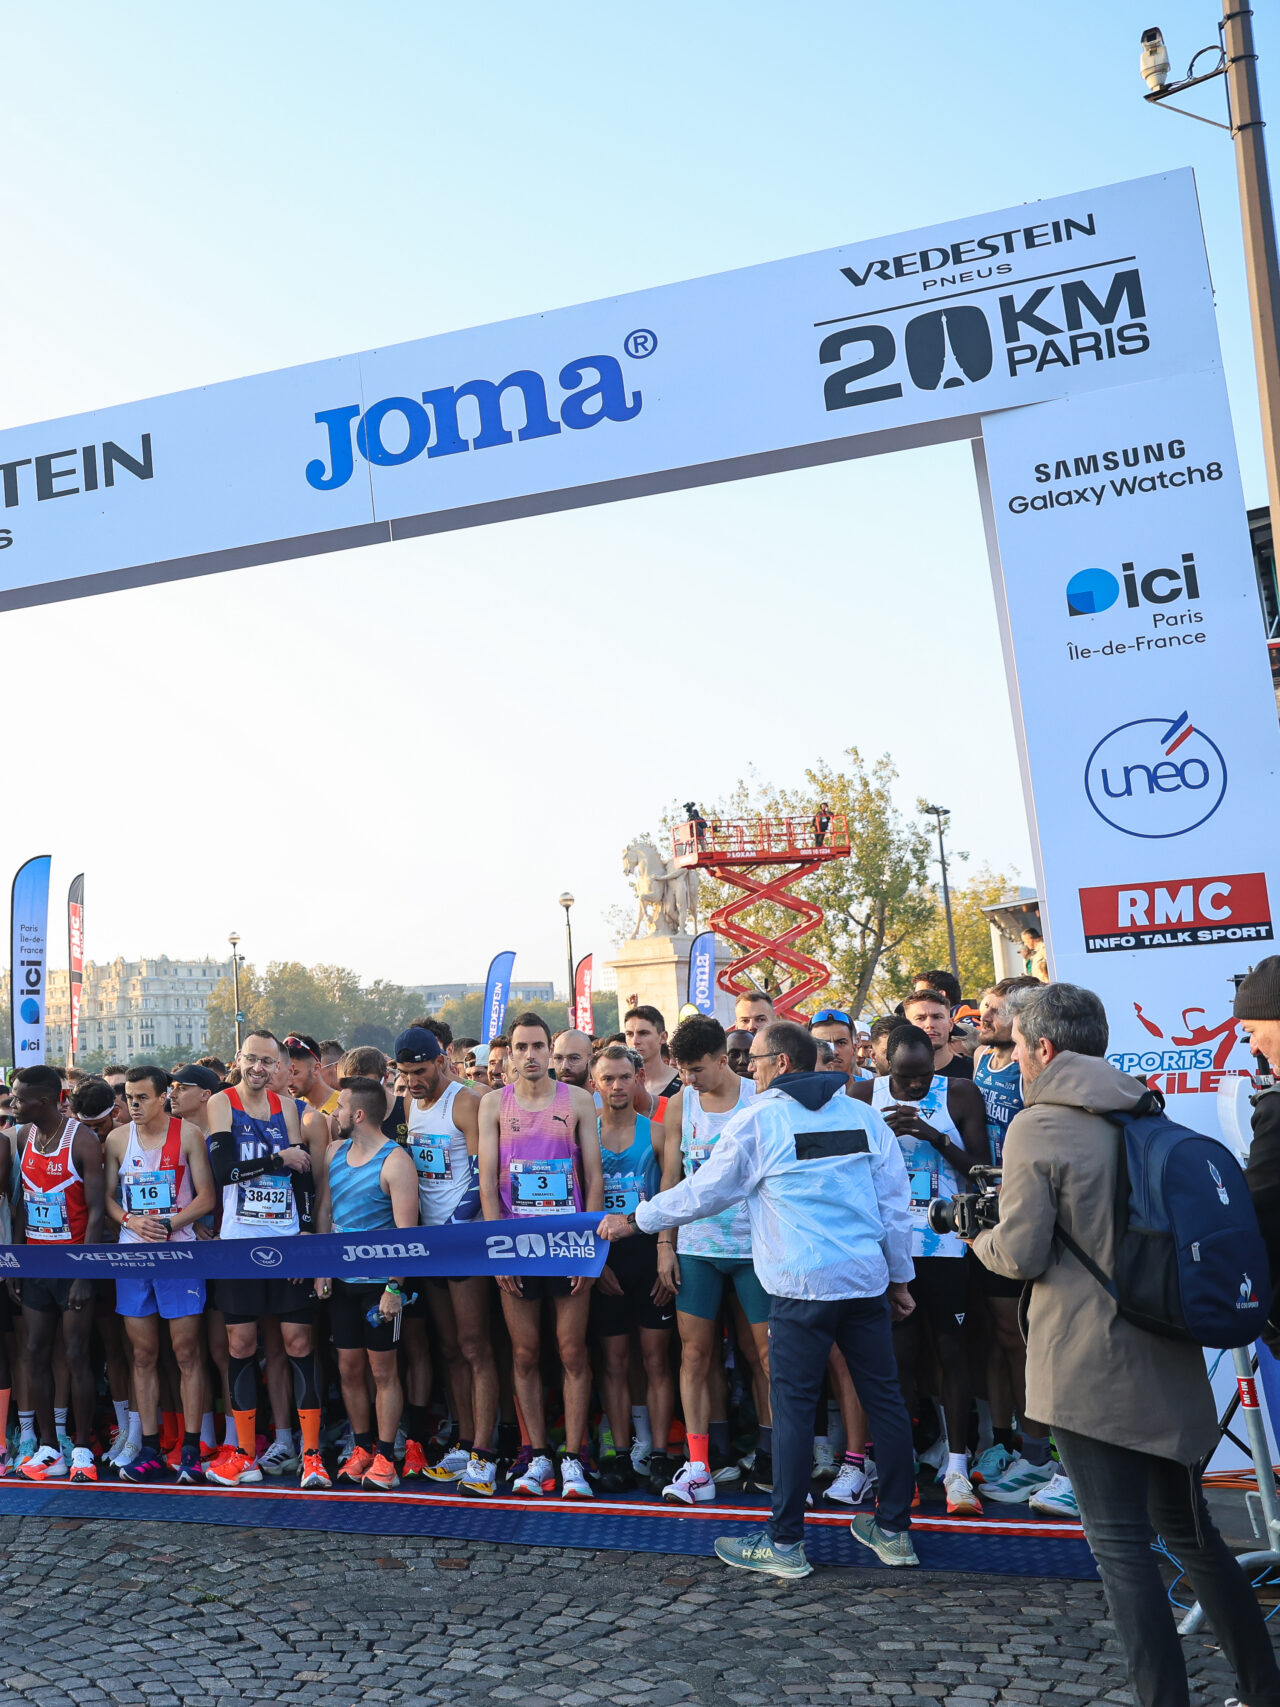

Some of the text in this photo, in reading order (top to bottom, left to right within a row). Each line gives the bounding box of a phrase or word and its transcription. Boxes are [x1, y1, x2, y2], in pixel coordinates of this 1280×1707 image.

[839, 212, 1097, 287] VREDESTEIN
[922, 263, 1013, 291] PNEUS
[819, 268, 1146, 411] 20 KM
[1006, 322, 1150, 377] PARIS
[1034, 439, 1187, 483] SAMSUNG
[1008, 462, 1223, 515] Galaxy Watch8
[1122, 552, 1200, 609] ici
[1152, 609, 1203, 629] Paris
[1066, 631, 1206, 660] Île-de-France
[1118, 882, 1233, 928] RMC
[20, 924, 39, 933] Paris
[71, 915, 82, 959] RMC
[1089, 926, 1270, 950] INFO TALK SPORT
[20, 946, 44, 955] France
[20, 960, 42, 995] ici
[28, 1039, 40, 1051] ici
[1106, 1050, 1212, 1072] SPORTS
[420, 1150, 434, 1162] 46
[140, 1187, 158, 1200] 16
[538, 1176, 548, 1189] 3
[248, 1190, 285, 1203] 38432
[604, 1195, 626, 1209] 55
[35, 1206, 49, 1218] 17
[66, 1251, 194, 1261] VREDESTEIN
[486, 1230, 595, 1259] 20 KM
[550, 1246, 595, 1258] PARIS
